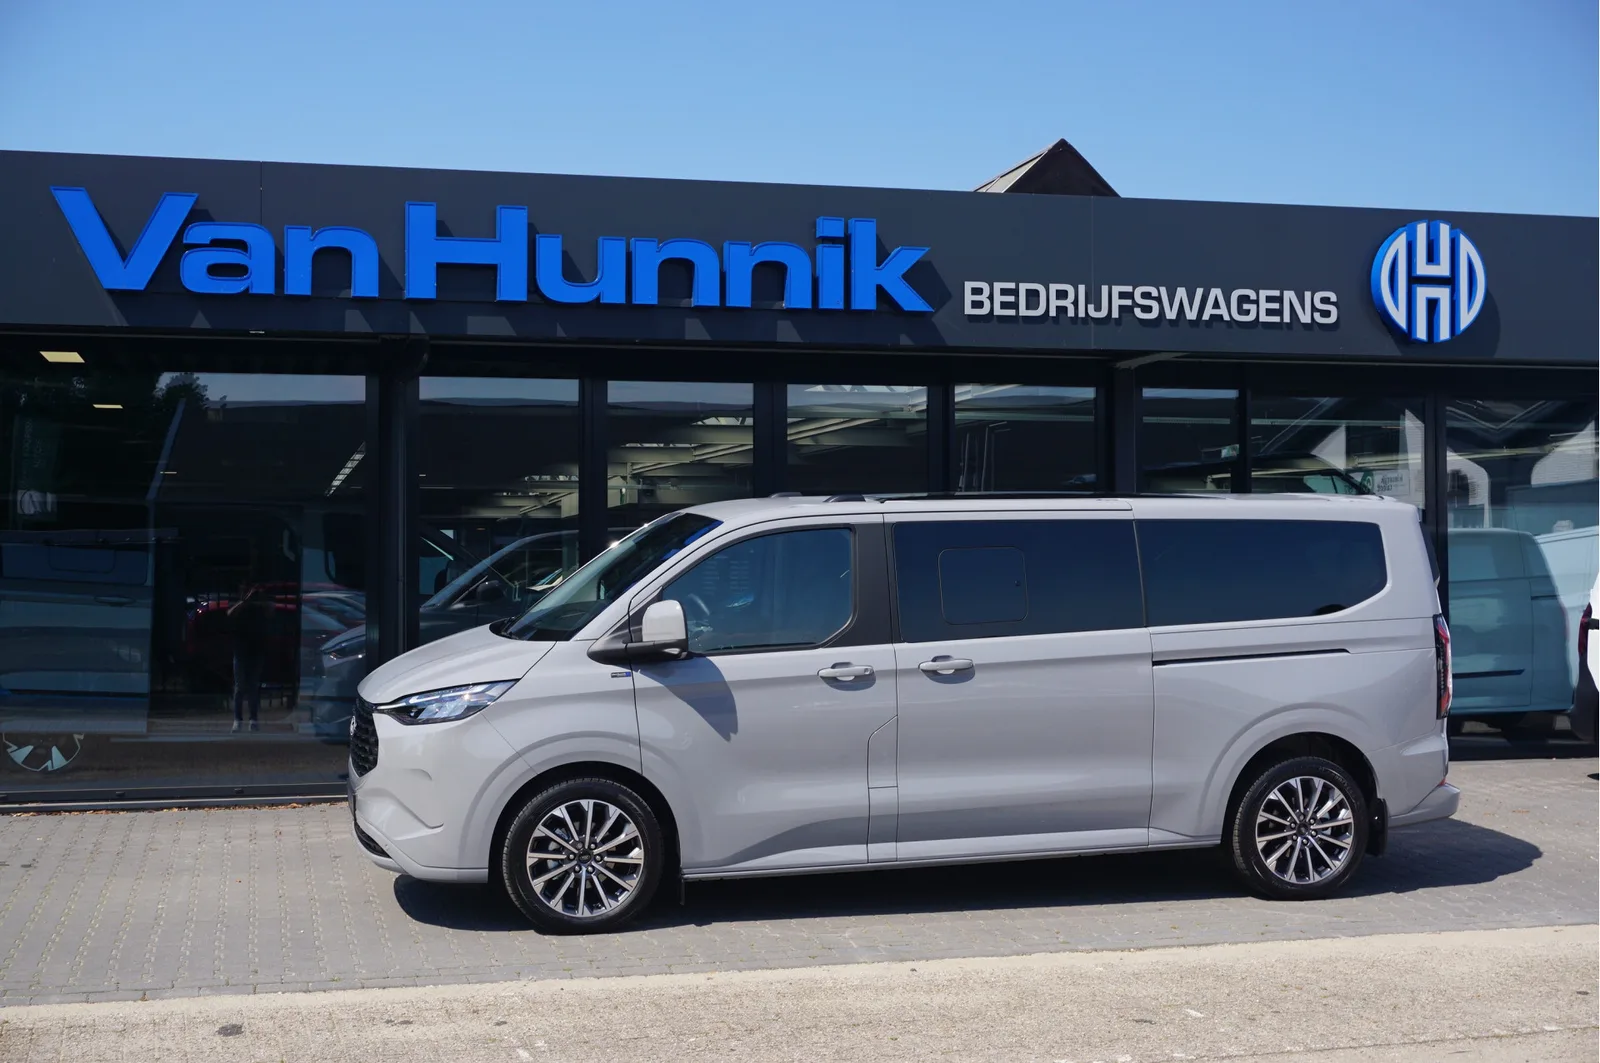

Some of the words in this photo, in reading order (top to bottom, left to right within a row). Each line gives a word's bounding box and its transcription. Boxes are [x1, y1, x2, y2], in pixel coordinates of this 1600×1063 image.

[50, 186, 379, 298] Van
[404, 201, 935, 313] Hunnik
[964, 281, 1339, 324] BEDRIJFSWAGENS
